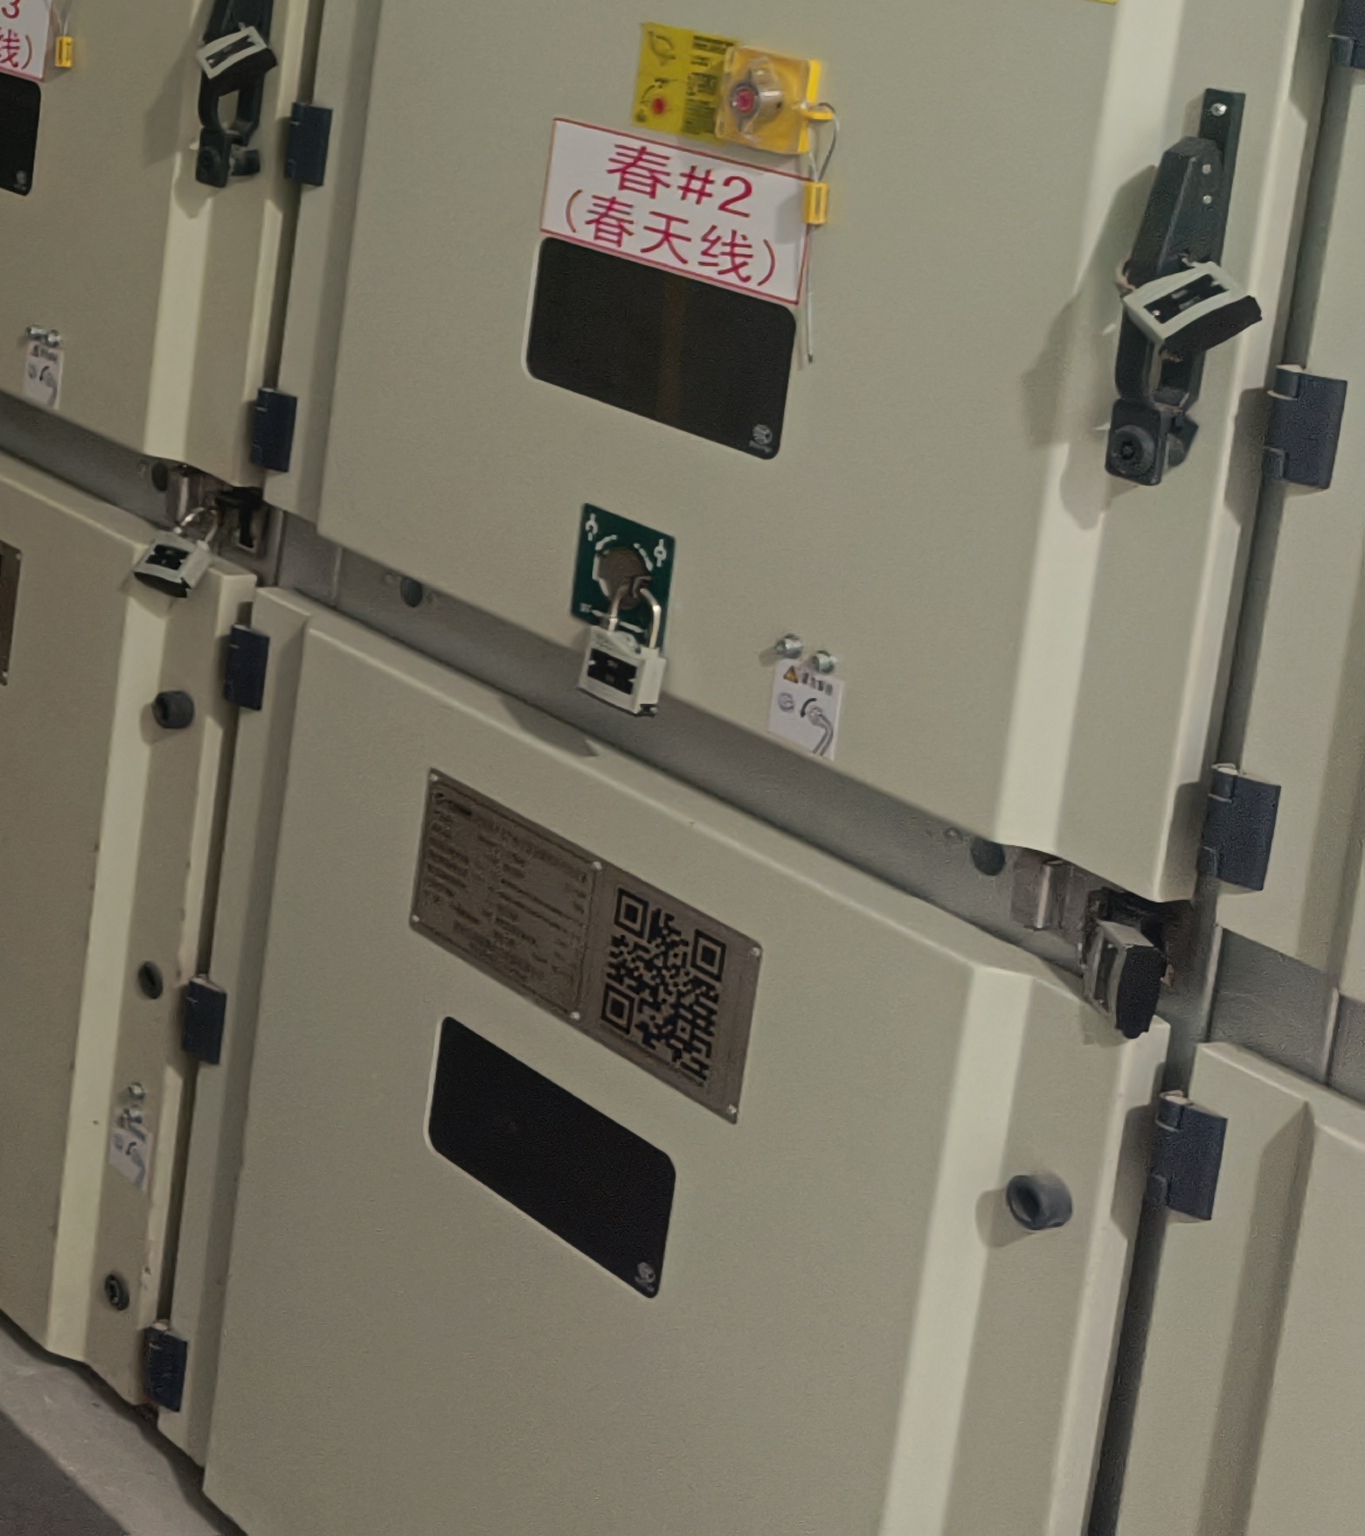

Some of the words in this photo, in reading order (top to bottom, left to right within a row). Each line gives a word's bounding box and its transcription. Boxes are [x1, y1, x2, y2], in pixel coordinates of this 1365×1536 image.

[606, 143, 753, 218] 春#2
[565, 189, 776, 287] (春天线)
